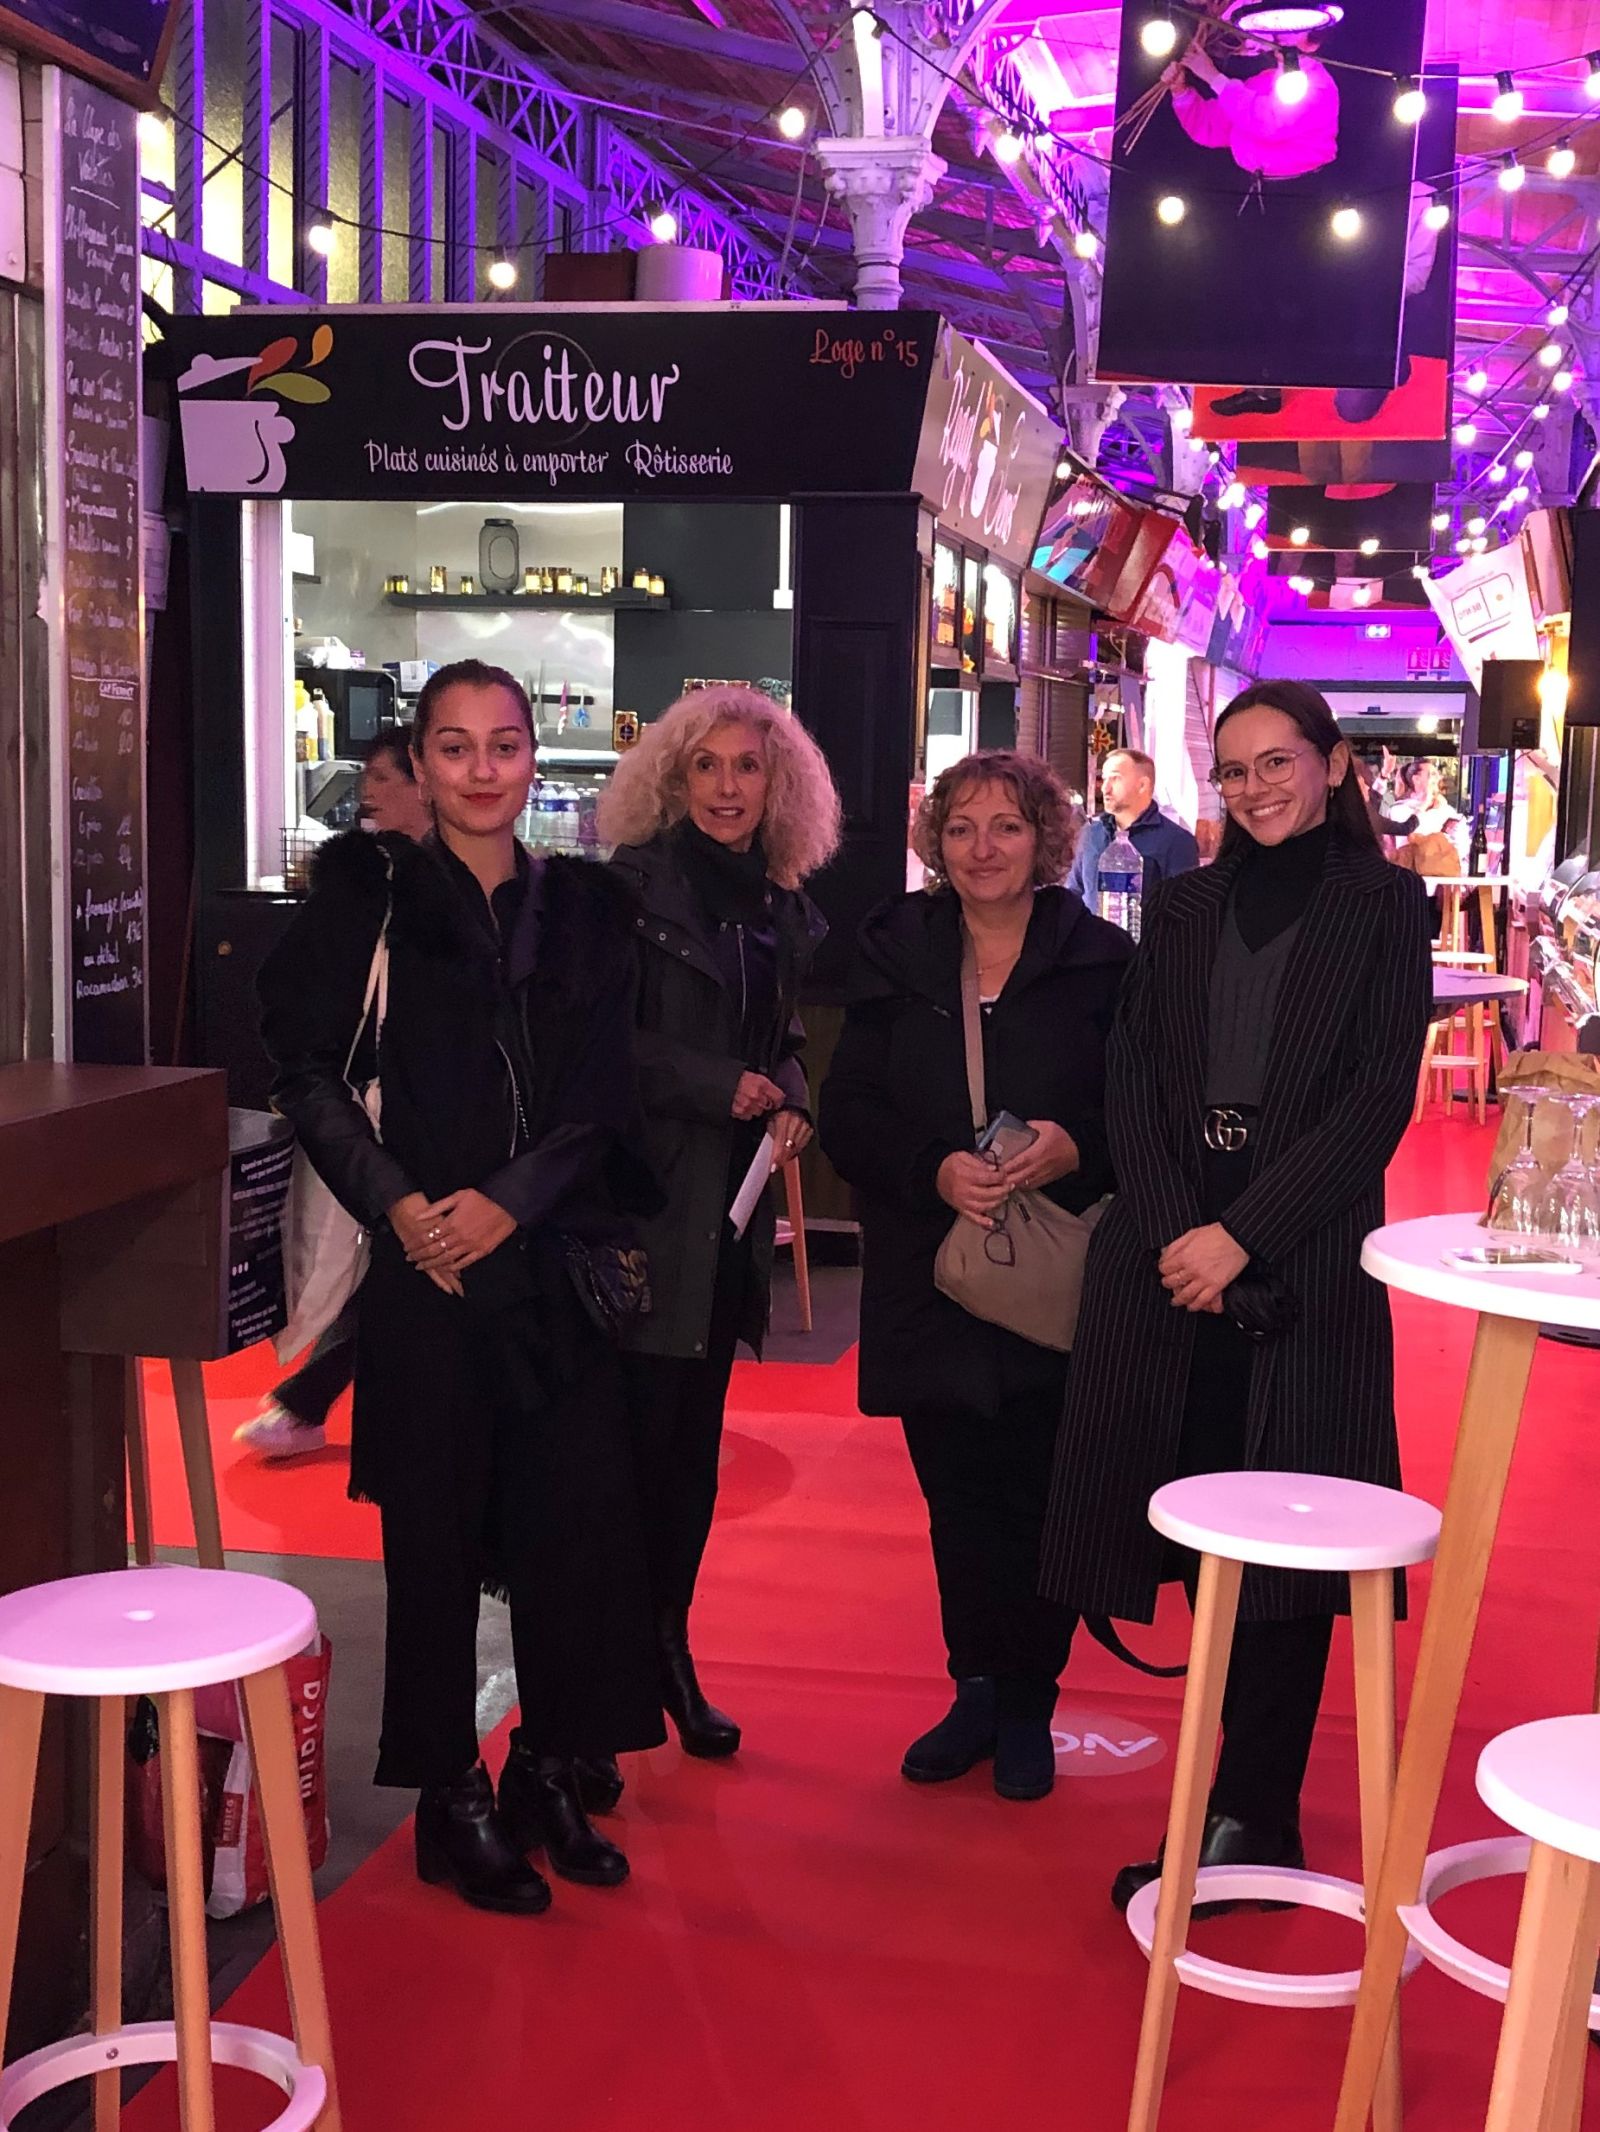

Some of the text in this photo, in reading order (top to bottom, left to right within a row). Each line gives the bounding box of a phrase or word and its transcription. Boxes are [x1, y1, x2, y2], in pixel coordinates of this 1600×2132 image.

[808, 328, 865, 379] Loge
[408, 335, 681, 431] Traiteur
[364, 438, 734, 487] Plats cuisinés à emporter Rôtisserie
